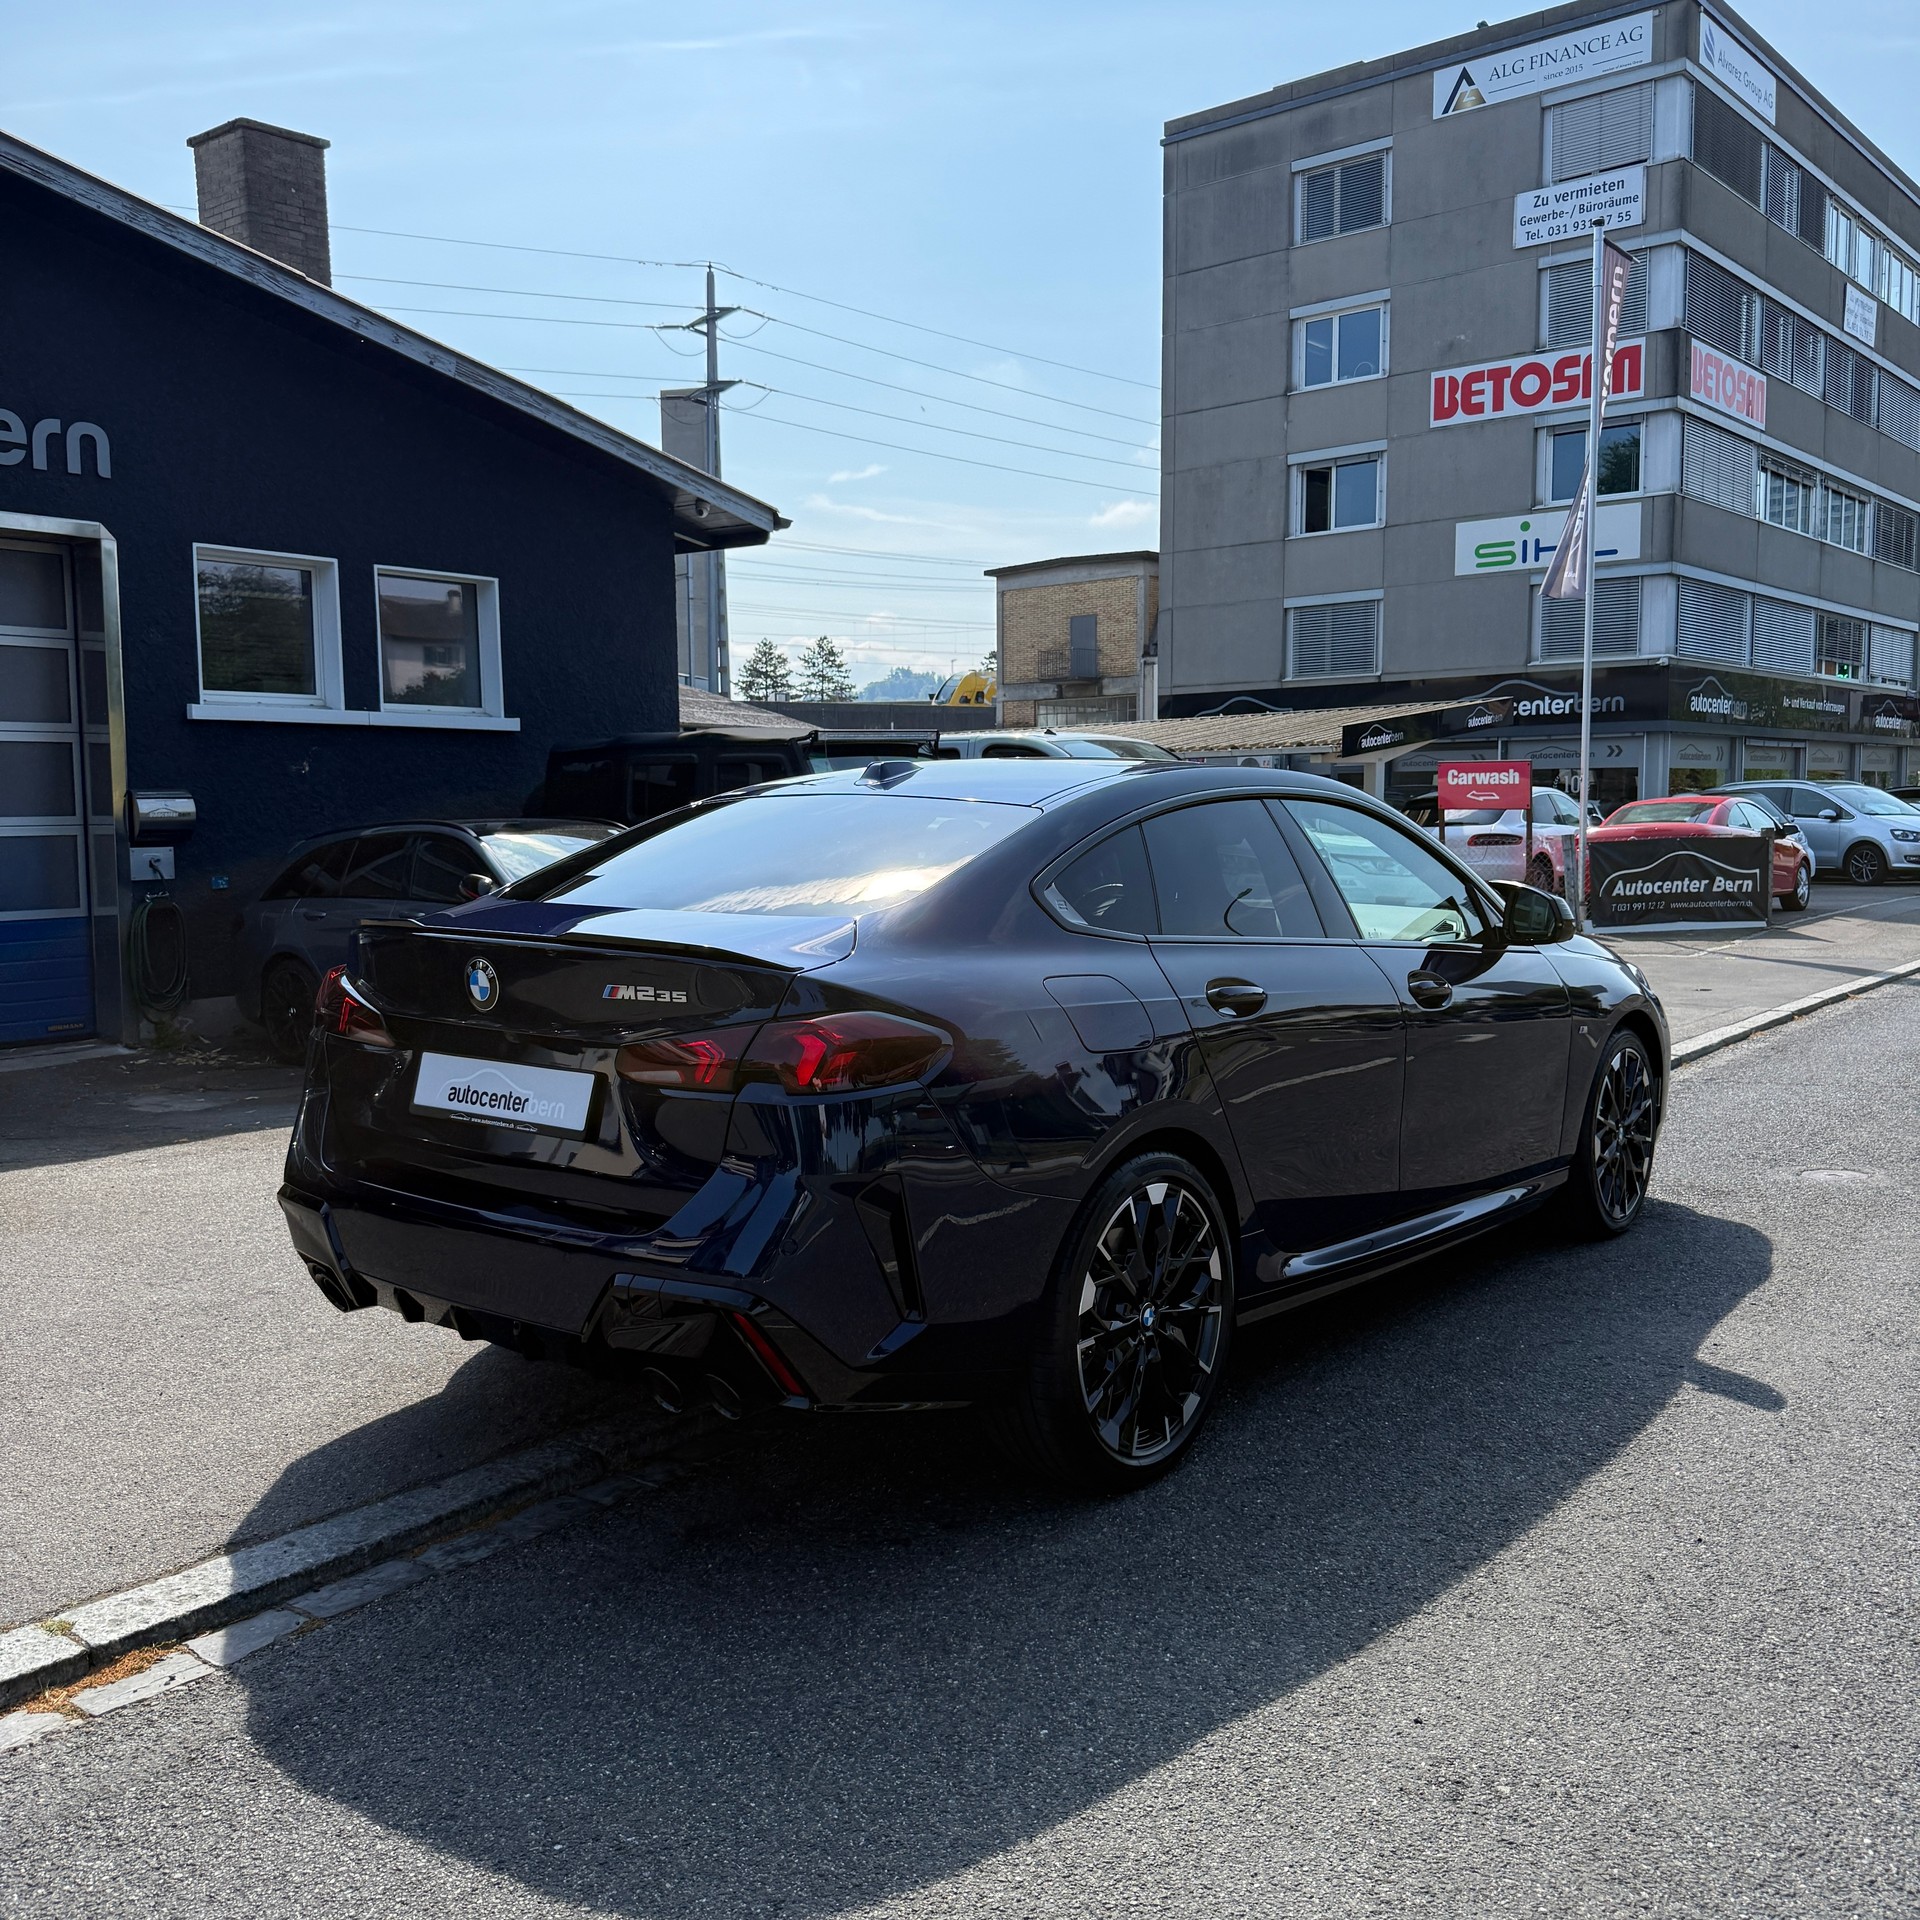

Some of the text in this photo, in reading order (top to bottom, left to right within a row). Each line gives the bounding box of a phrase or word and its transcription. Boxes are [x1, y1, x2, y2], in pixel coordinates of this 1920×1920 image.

[1488, 25, 1644, 82] ALG FINANCE AG
[1543, 63, 1584, 81] since 2015
[1718, 49, 1774, 109] Alvarez Group AG
[1533, 179, 1625, 209] Zu vermieten
[1525, 229, 1544, 241] Tel.
[1547, 225, 1568, 237] 031
[1572, 218, 1593, 232] 931
[1617, 210, 1632, 223] 55
[1692, 345, 1765, 425] BETOSAN
[0, 408, 111, 479] ern
[1530, 749, 1595, 760] autocenterbn
[1447, 768, 1520, 785] Carwash
[1612, 876, 1752, 896] Autocenter Bern
[1612, 904, 1617, 912] T
[1617, 903, 1630, 912] 031
[1632, 902, 1646, 911] 991
[1670, 899, 1753, 909] www.autocenterbern.ch
[617, 985, 687, 1003] M235
[448, 1085, 565, 1119] autocenterbern
